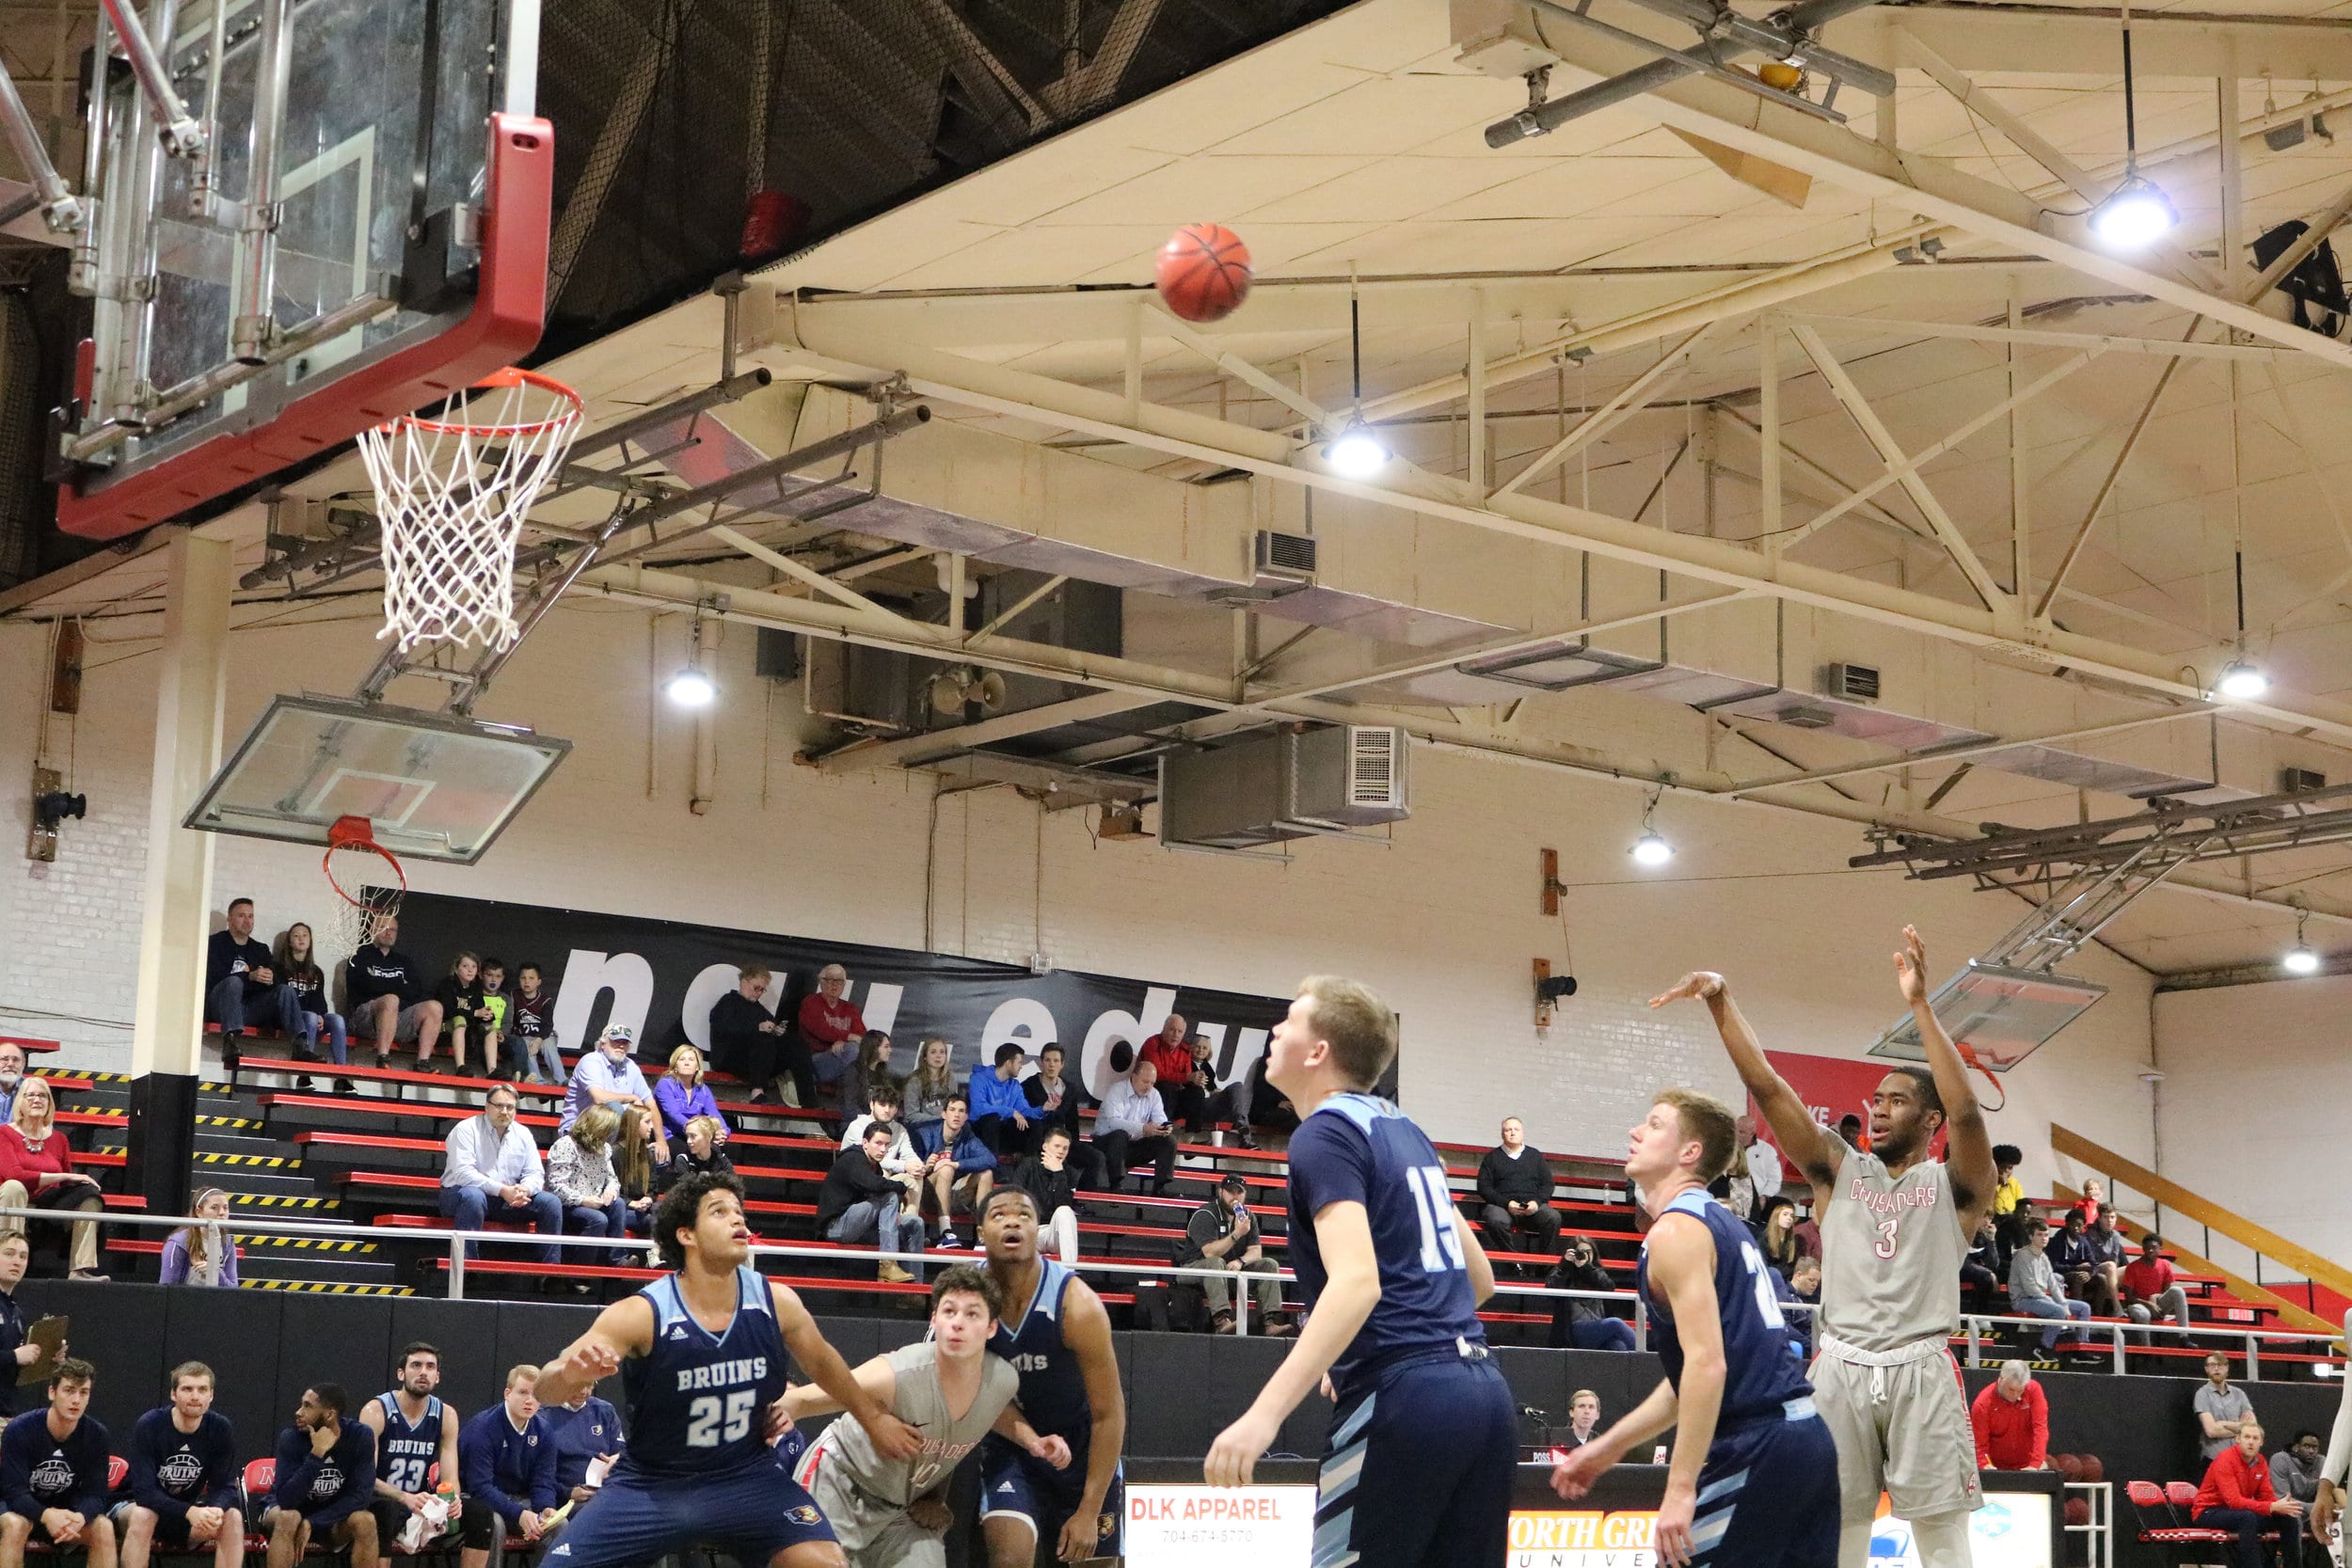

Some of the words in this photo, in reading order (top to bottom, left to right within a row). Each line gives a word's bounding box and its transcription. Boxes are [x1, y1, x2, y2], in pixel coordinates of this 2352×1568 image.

[1875, 1218, 1899, 1259] 3
[676, 1356, 768, 1391] BRUINS
[686, 1388, 756, 1448] 25
[388, 1439, 435, 1455] BRUINS
[157, 1465, 203, 1480] BRUINS
[387, 1458, 426, 1493] 23
[1131, 1497, 1176, 1521] DLK
[1183, 1497, 1282, 1521] APPAREL
[1508, 1516, 1600, 1549] ORTH
